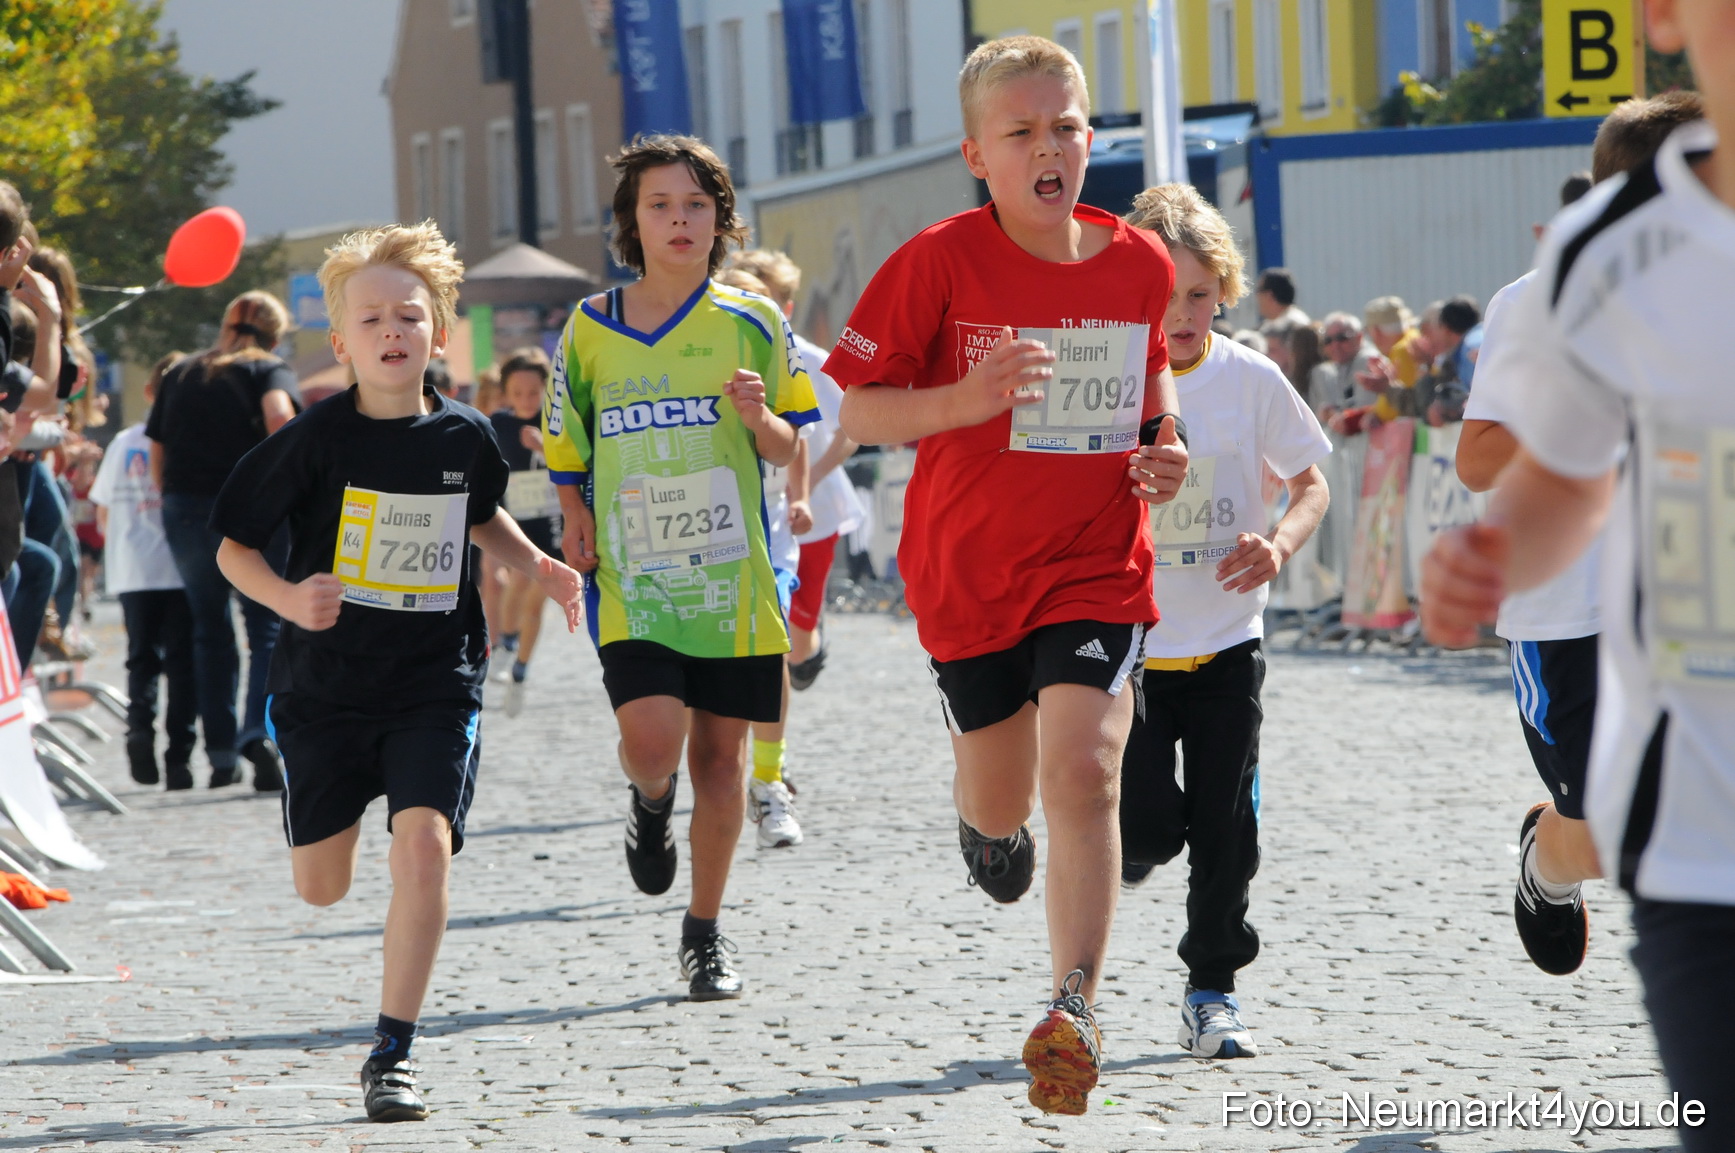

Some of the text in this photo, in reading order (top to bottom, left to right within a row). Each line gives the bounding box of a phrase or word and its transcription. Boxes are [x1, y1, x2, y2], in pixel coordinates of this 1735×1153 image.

[1569, 10, 1618, 81] B
[1060, 339, 1108, 361] Henri
[601, 374, 669, 404] TEAM
[1060, 375, 1137, 411] 7092
[601, 396, 721, 438] BOCK
[1027, 437, 1067, 446] BOCK
[650, 486, 686, 504] Luca
[381, 504, 432, 527] Jonas
[627, 504, 733, 540] K 7232
[1150, 498, 1235, 531] 7048
[343, 532, 454, 573] K4 7266
[702, 544, 746, 560] PFLEIDERER
[1075, 649, 1109, 662] adidas
